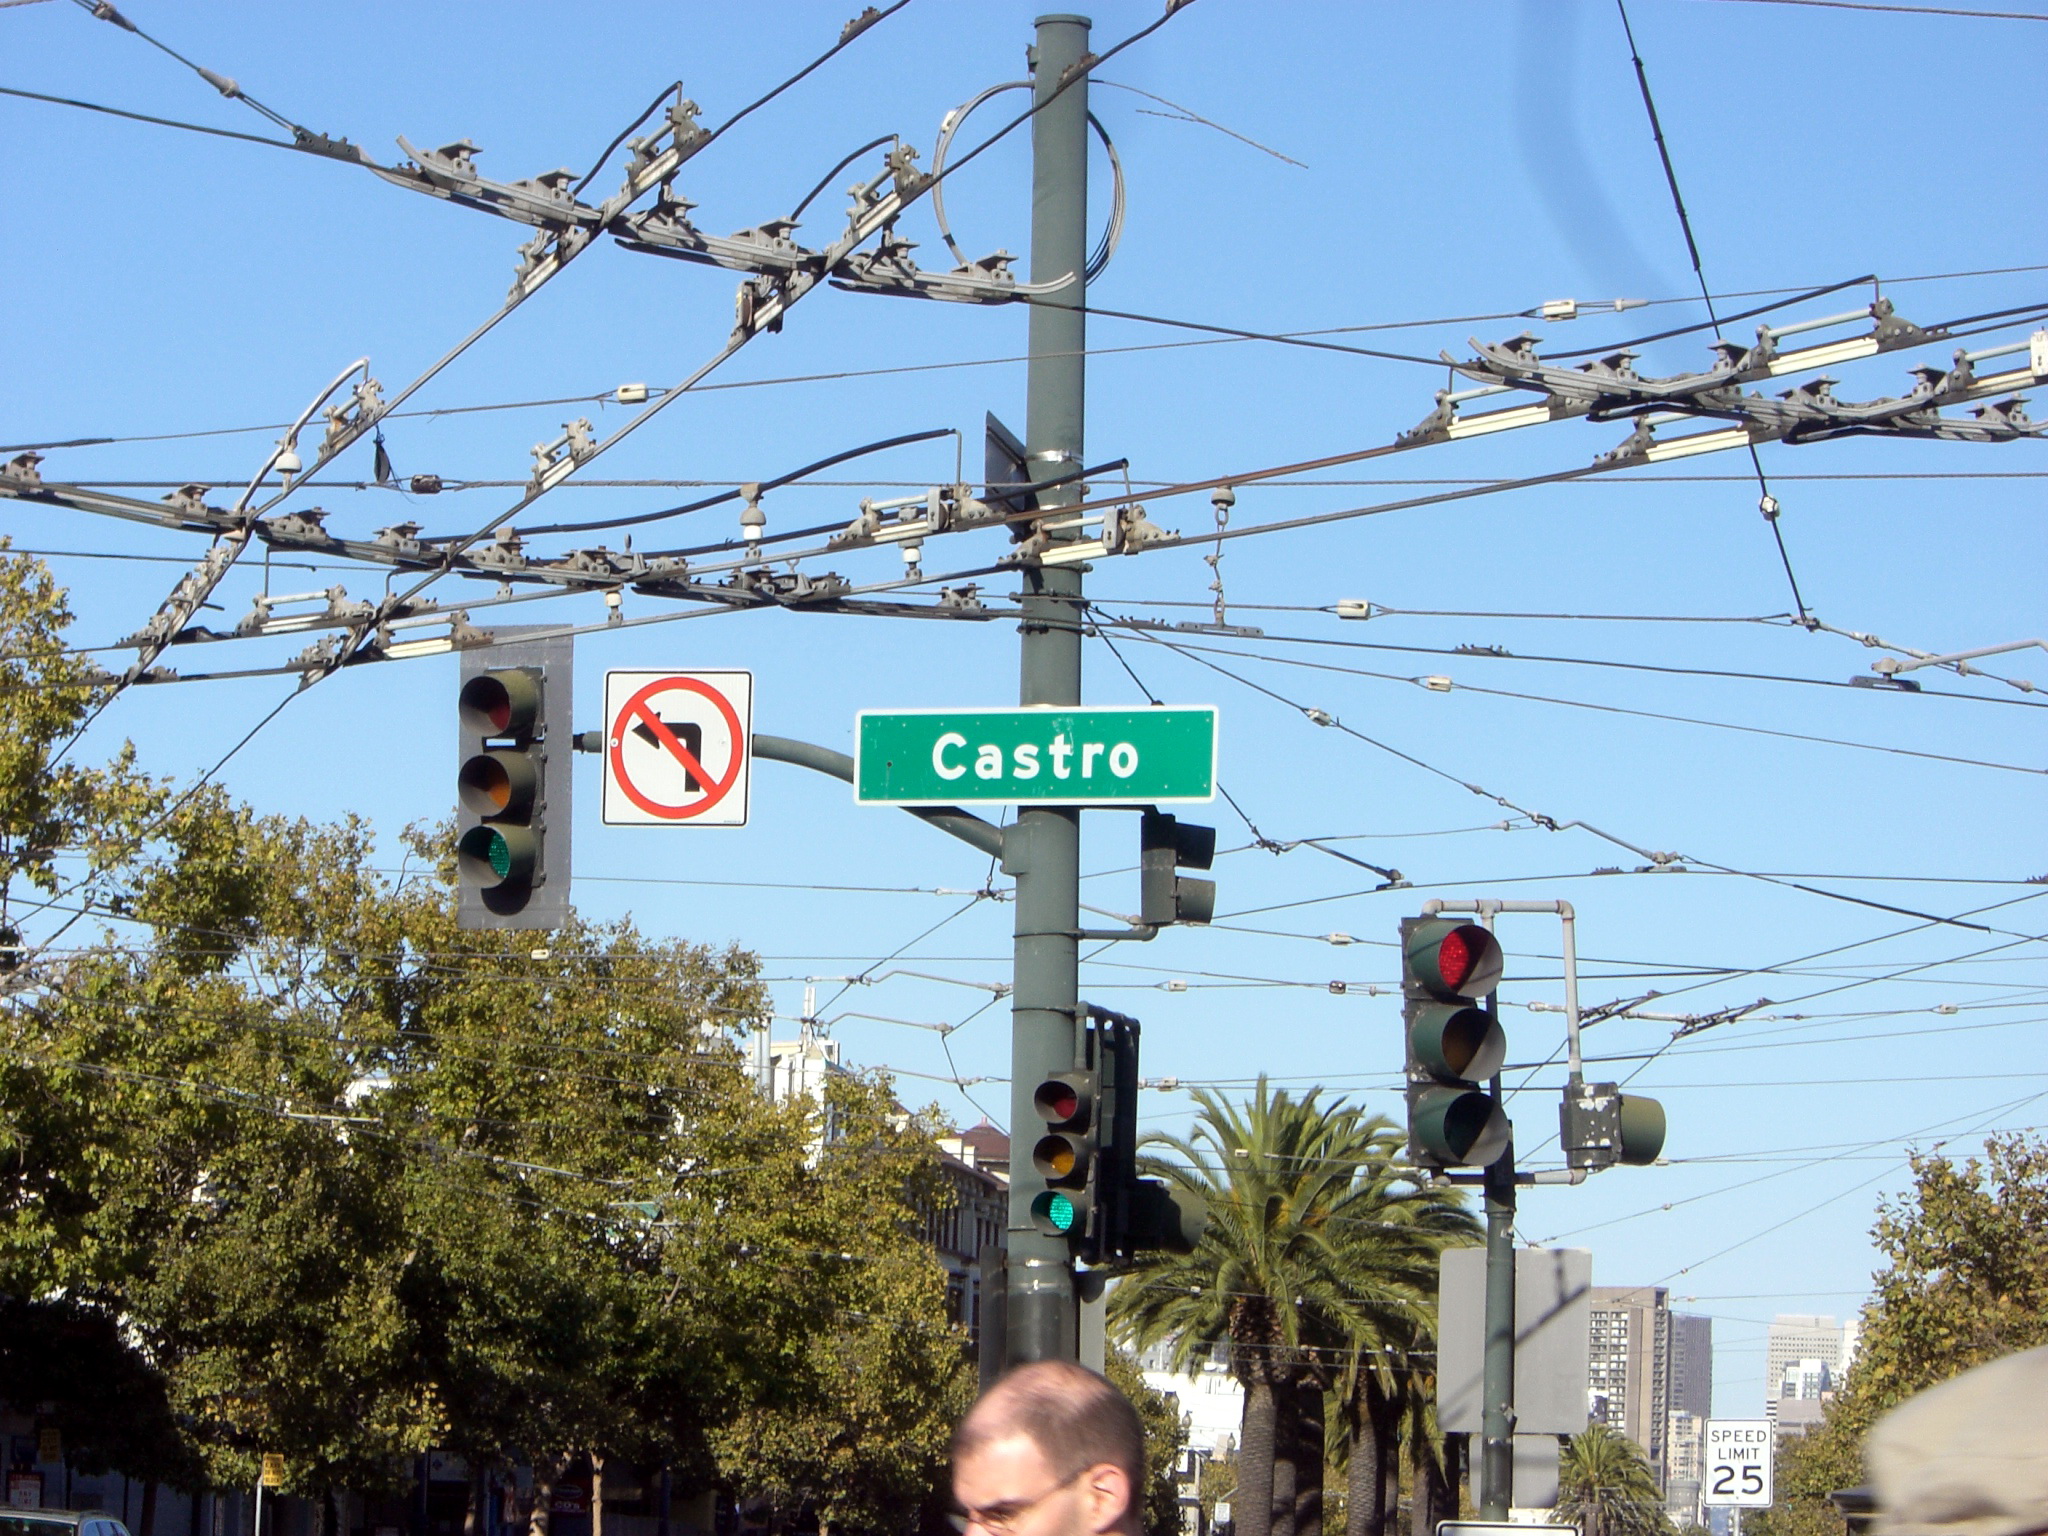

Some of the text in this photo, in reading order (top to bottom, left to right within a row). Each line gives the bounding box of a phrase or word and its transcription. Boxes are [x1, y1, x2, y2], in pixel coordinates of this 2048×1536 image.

[932, 732, 1139, 780] Castro
[1711, 1430, 1767, 1443] SPEED
[1718, 1447, 1760, 1460] LIMIT
[1712, 1465, 1763, 1495] 25
